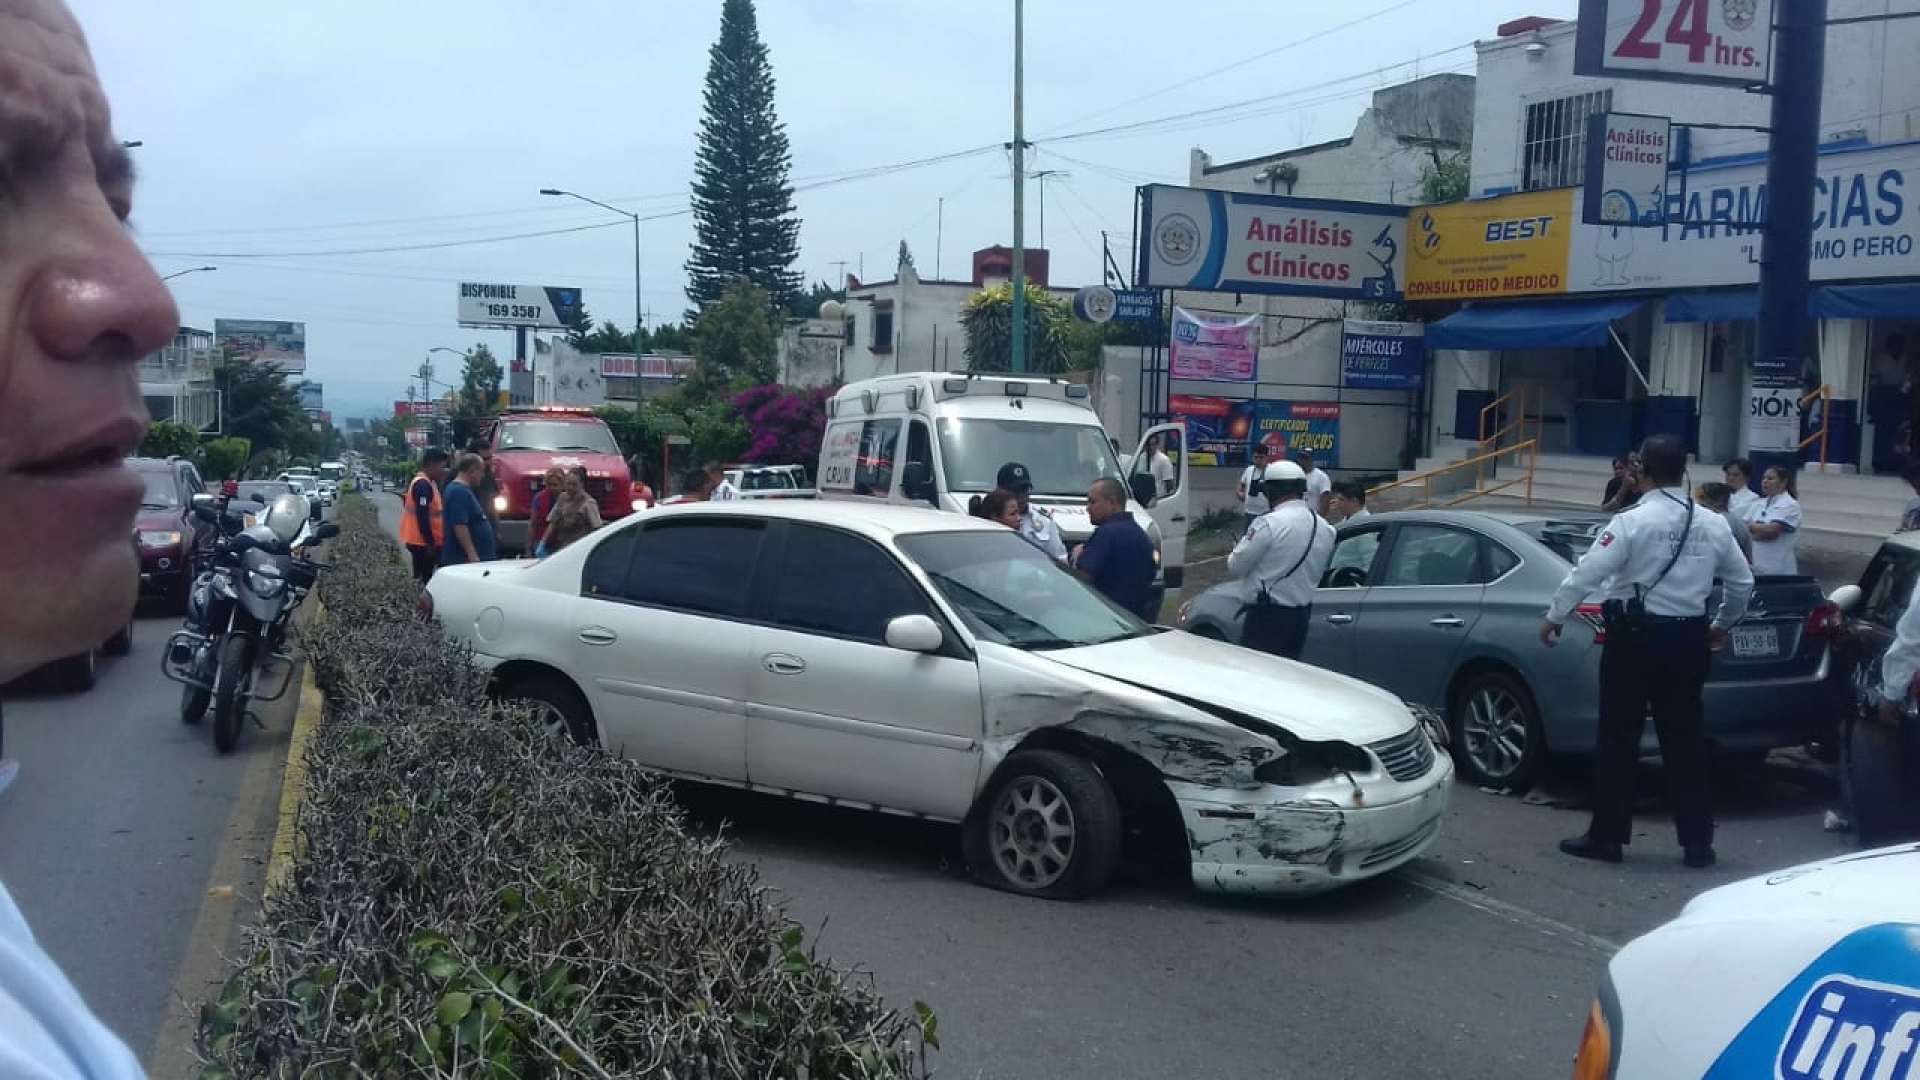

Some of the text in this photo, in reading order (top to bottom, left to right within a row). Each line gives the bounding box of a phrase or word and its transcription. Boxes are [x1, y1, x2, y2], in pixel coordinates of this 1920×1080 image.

[1612, 0, 1762, 67] 24 hrs.
[1607, 129, 1665, 146] Análisis
[1606, 146, 1663, 164] Clínicos
[1662, 168, 1905, 242] FARMCIAS
[1246, 216, 1353, 247] Análisis
[1485, 216, 1554, 243] BEST
[1852, 234, 1913, 258] PERO
[1246, 251, 1351, 282] Clínicos
[461, 282, 517, 299] DISPONIBLE
[1408, 273, 1560, 295] CONSULTORIO MEDICO
[488, 304, 509, 317] 169
[1345, 335, 1403, 356] MIÉRCOLES
[1659, 529, 1711, 543] POLCIA
[1791, 992, 1920, 1080] inf
